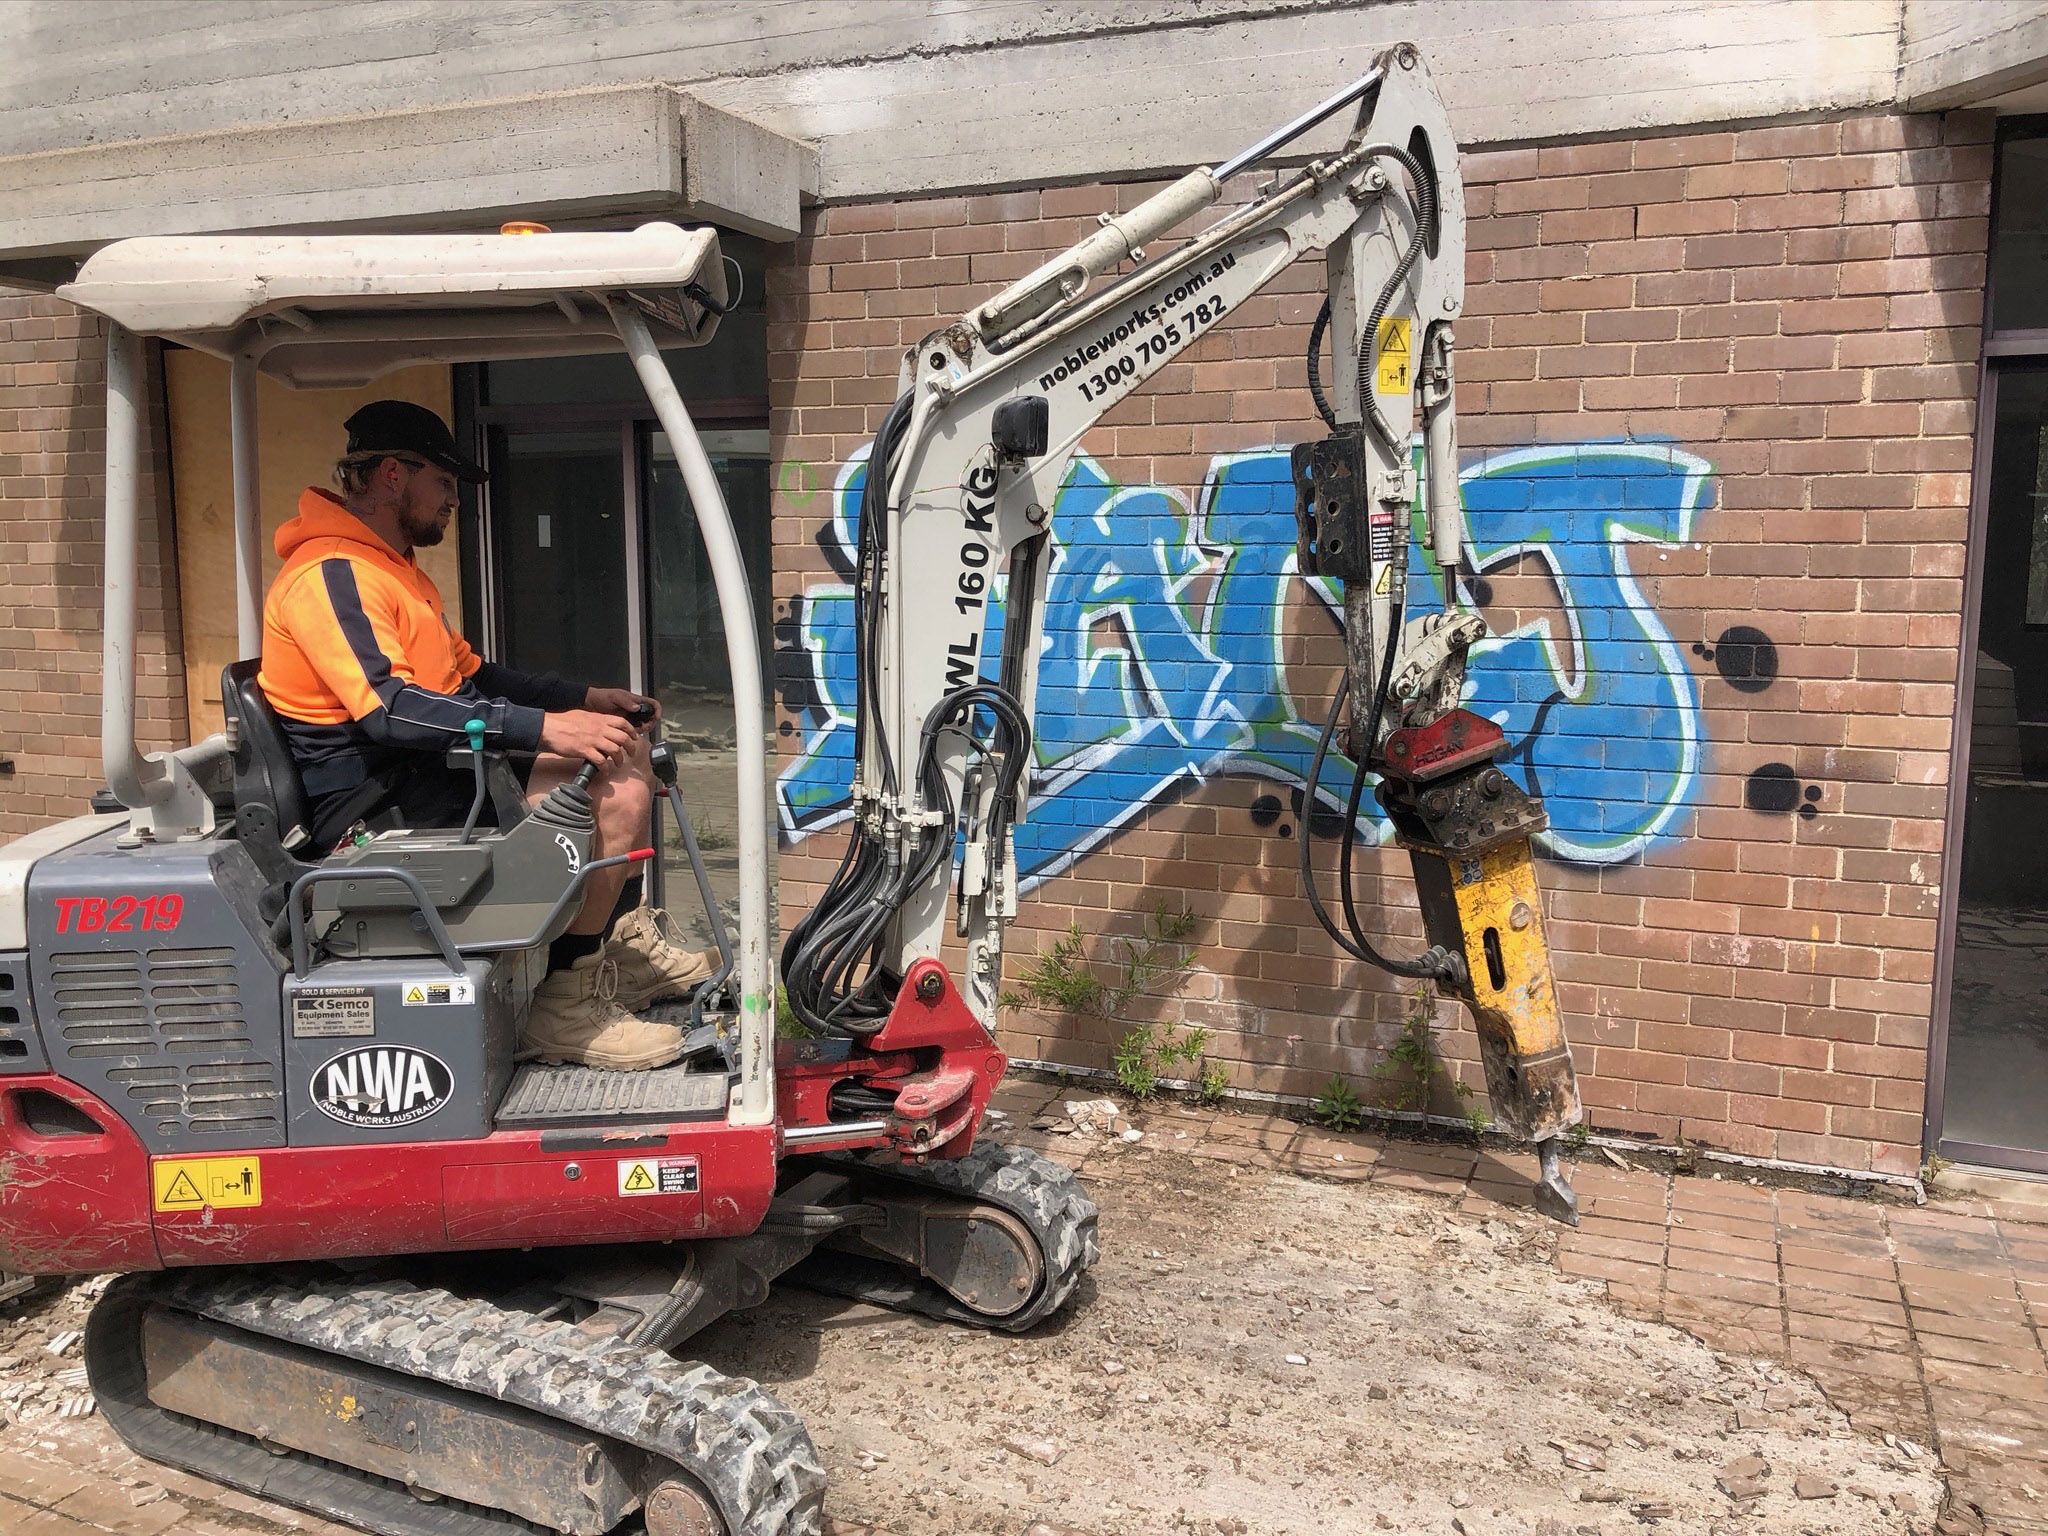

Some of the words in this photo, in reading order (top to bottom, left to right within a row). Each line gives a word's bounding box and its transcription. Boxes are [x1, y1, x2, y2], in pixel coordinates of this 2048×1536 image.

[1039, 252, 1236, 391] nobleworks.com.au
[1078, 356, 1135, 402] 1300
[1135, 324, 1181, 365] 705
[1181, 295, 1227, 335] 782
[964, 467, 999, 533] KG
[955, 543, 990, 615] 160
[54, 893, 185, 935] TB219
[297, 1011, 344, 1020] Equipment
[346, 1010, 370, 1018] Sales
[301, 988, 319, 996] SOLD
[325, 987, 355, 996] SERVICED
[356, 987, 366, 995] BY
[326, 999, 370, 1010] Semco
[327, 1050, 435, 1114] NWA
[322, 1100, 354, 1121] NOBLE
[392, 1096, 444, 1124] AUSTRALIA
